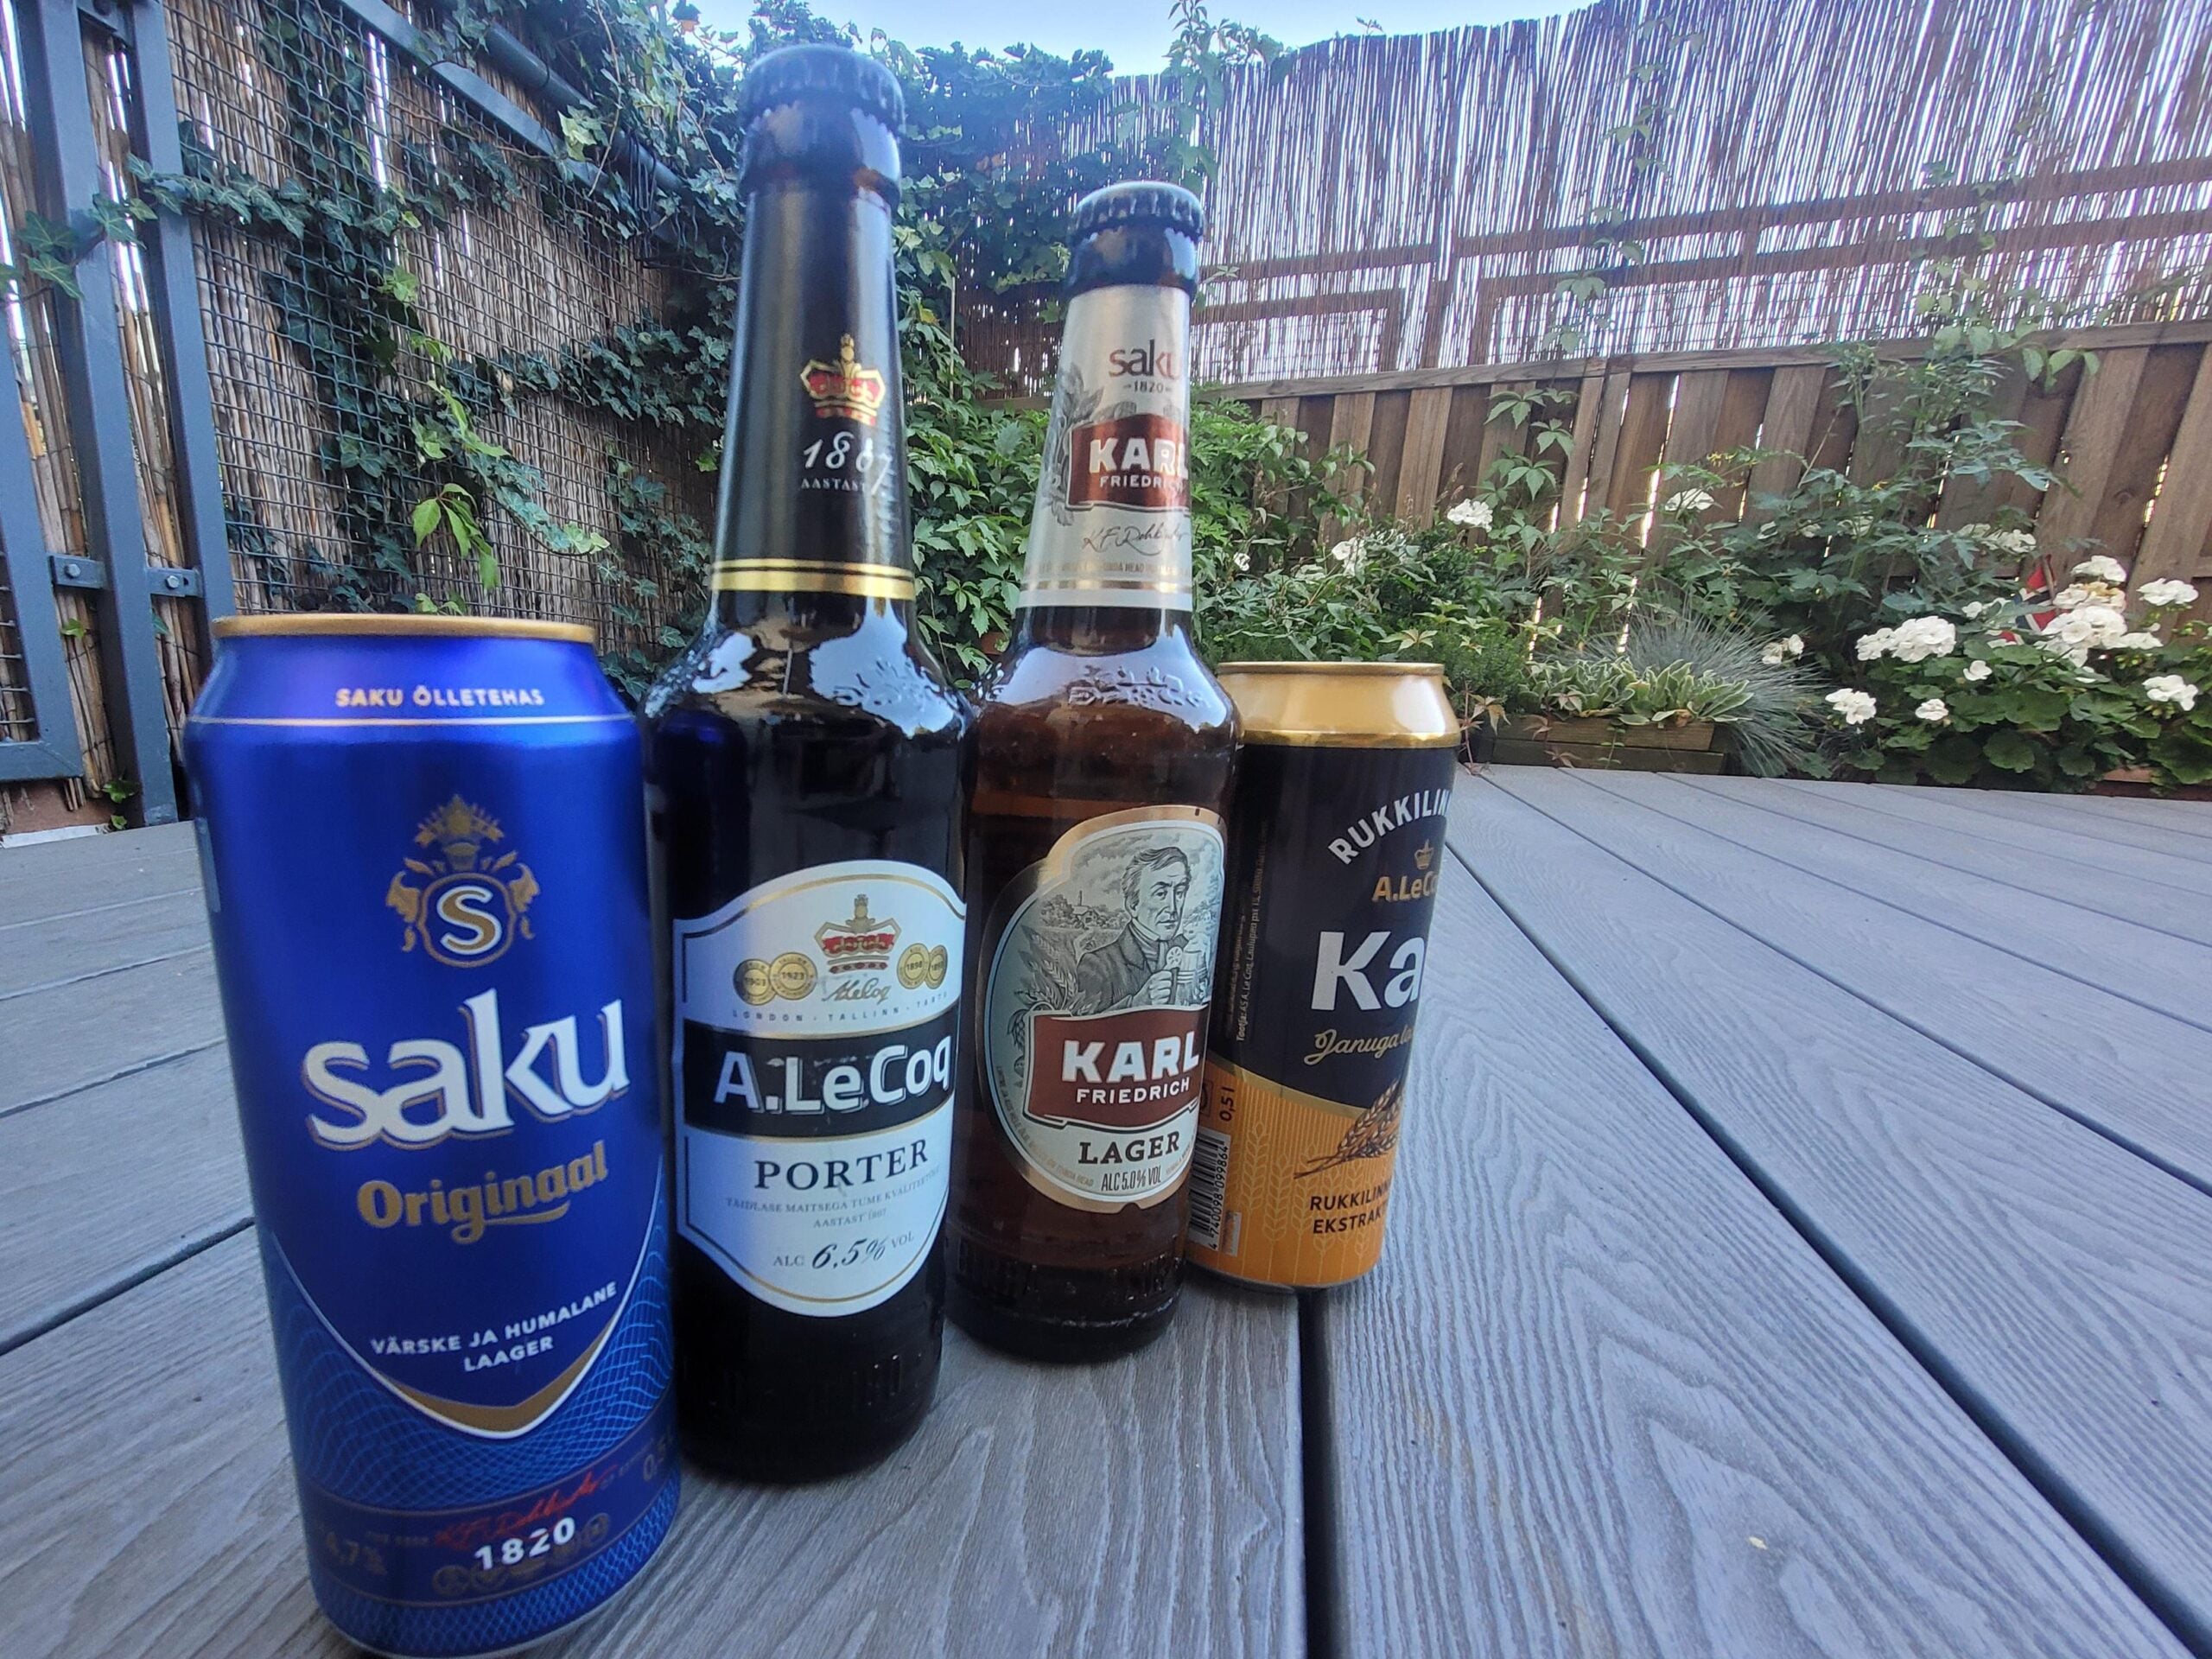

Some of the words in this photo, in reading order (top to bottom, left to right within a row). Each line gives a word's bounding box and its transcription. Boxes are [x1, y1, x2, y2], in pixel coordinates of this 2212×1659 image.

[1089, 437, 1189, 480] KARL
[335, 687, 404, 707] SAKU
[413, 683, 545, 707] ÕLLETEHAS
[1311, 931, 1426, 1011] Ka
[828, 1006, 899, 1021] TALLINN
[300, 988, 631, 1150] saku
[714, 1034, 952, 1113] A.LeCoq
[1061, 1031, 1199, 1084] KARL
[1077, 1085, 1191, 1104] FRIEDRICH
[754, 1139, 929, 1191] PORTER
[1077, 1131, 1180, 1165] LAGER
[357, 1141, 609, 1245] Originaal
[1101, 1172, 1121, 1192] ALC
[1147, 1165, 1162, 1186] VOL
[785, 1201, 849, 1213] MAITSEGA
[852, 1193, 883, 1208] TUME
[812, 1211, 864, 1229] AASTAST
[772, 1255, 805, 1268] ALC
[891, 1230, 915, 1249] VOL
[371, 1333, 462, 1357] VÄRSKE
[469, 1326, 499, 1350] JA
[504, 1281, 619, 1340] HUMALANE
[464, 1336, 554, 1373] LAAGER
[474, 1516, 577, 1572] 1820
